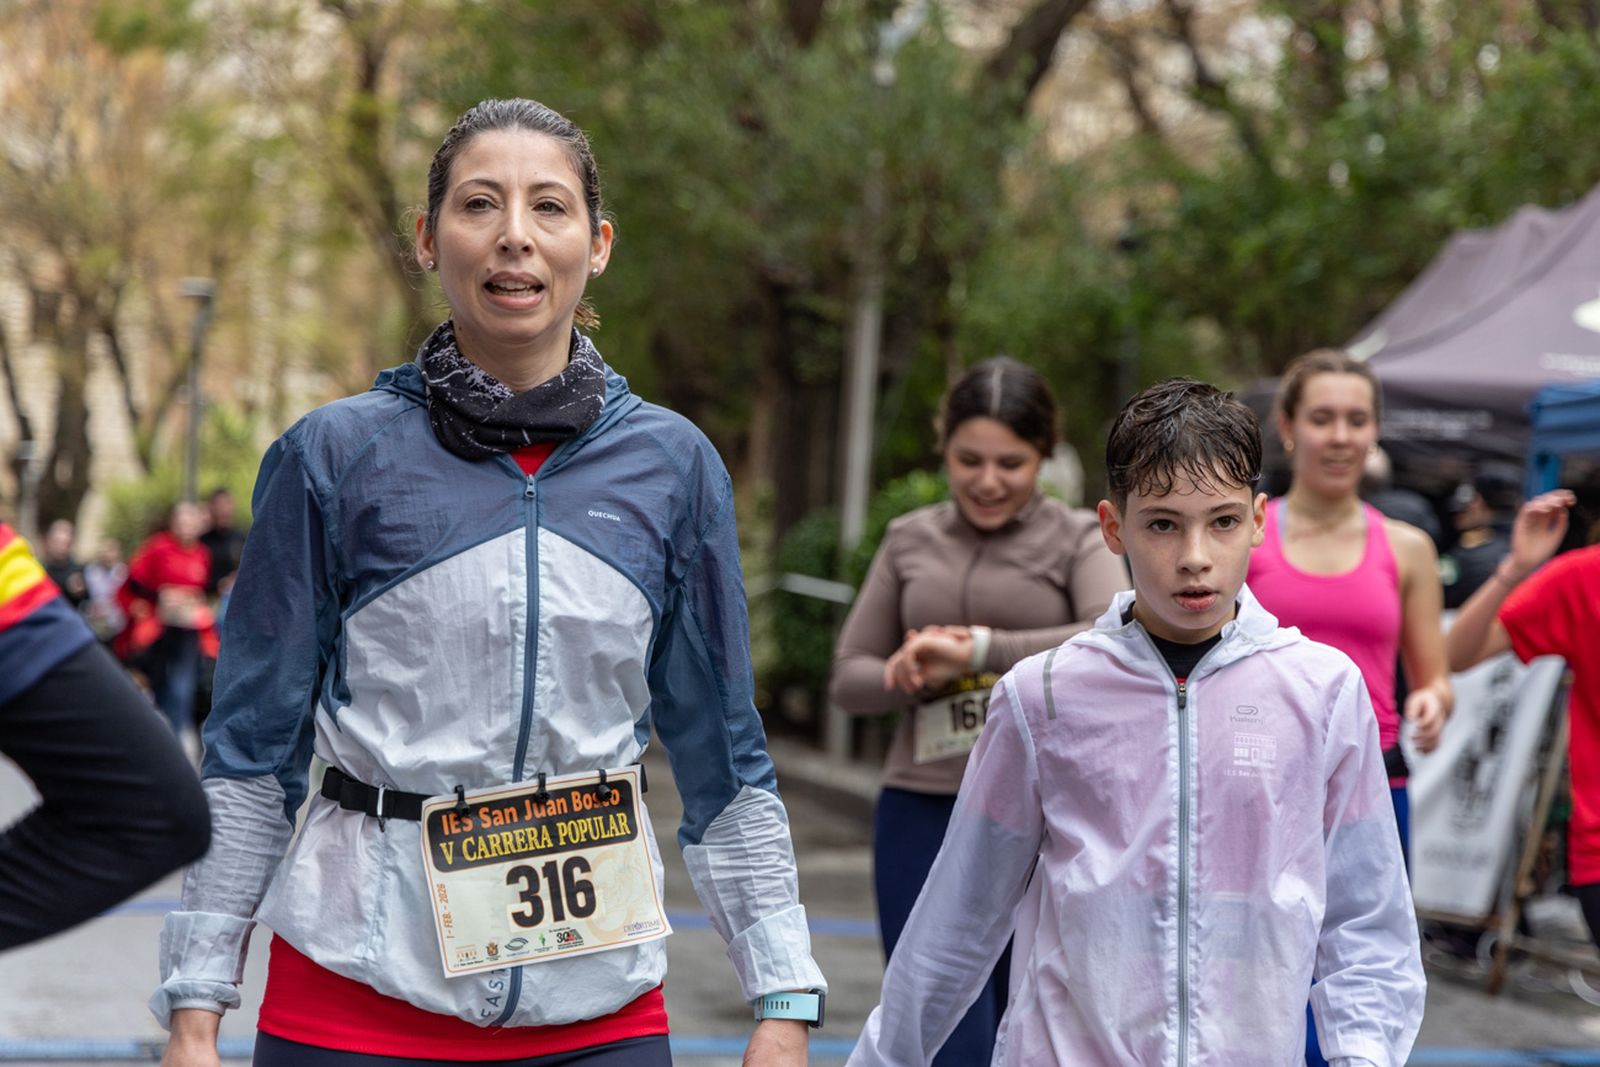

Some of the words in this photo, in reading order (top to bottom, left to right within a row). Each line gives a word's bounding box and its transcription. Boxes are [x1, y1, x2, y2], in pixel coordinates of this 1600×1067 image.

[587, 510, 621, 521] QUECHUA
[439, 841, 454, 865] V
[462, 826, 553, 862] CARRERA
[557, 812, 631, 846] POPULAR
[442, 812, 473, 836] IES
[479, 806, 518, 829] San
[524, 795, 568, 820] Juan
[505, 856, 597, 928] 316
